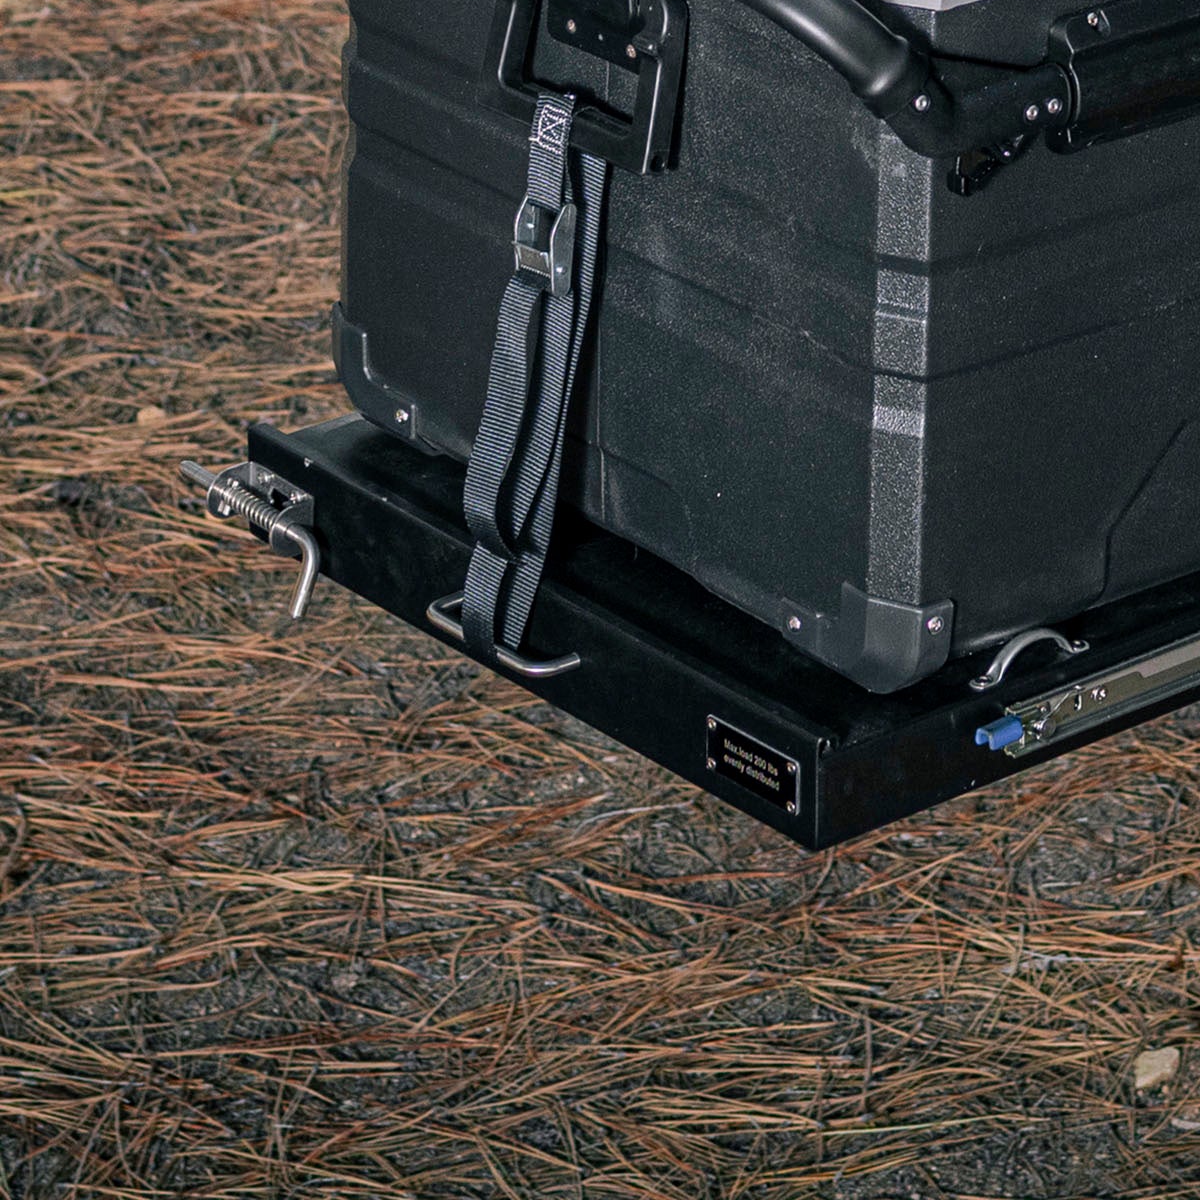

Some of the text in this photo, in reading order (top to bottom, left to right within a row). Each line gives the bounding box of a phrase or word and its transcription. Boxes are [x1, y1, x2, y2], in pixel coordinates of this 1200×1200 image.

[723, 754, 780, 791] evenly distributed
[754, 755, 767, 770] 200
[767, 762, 778, 777] lbs
